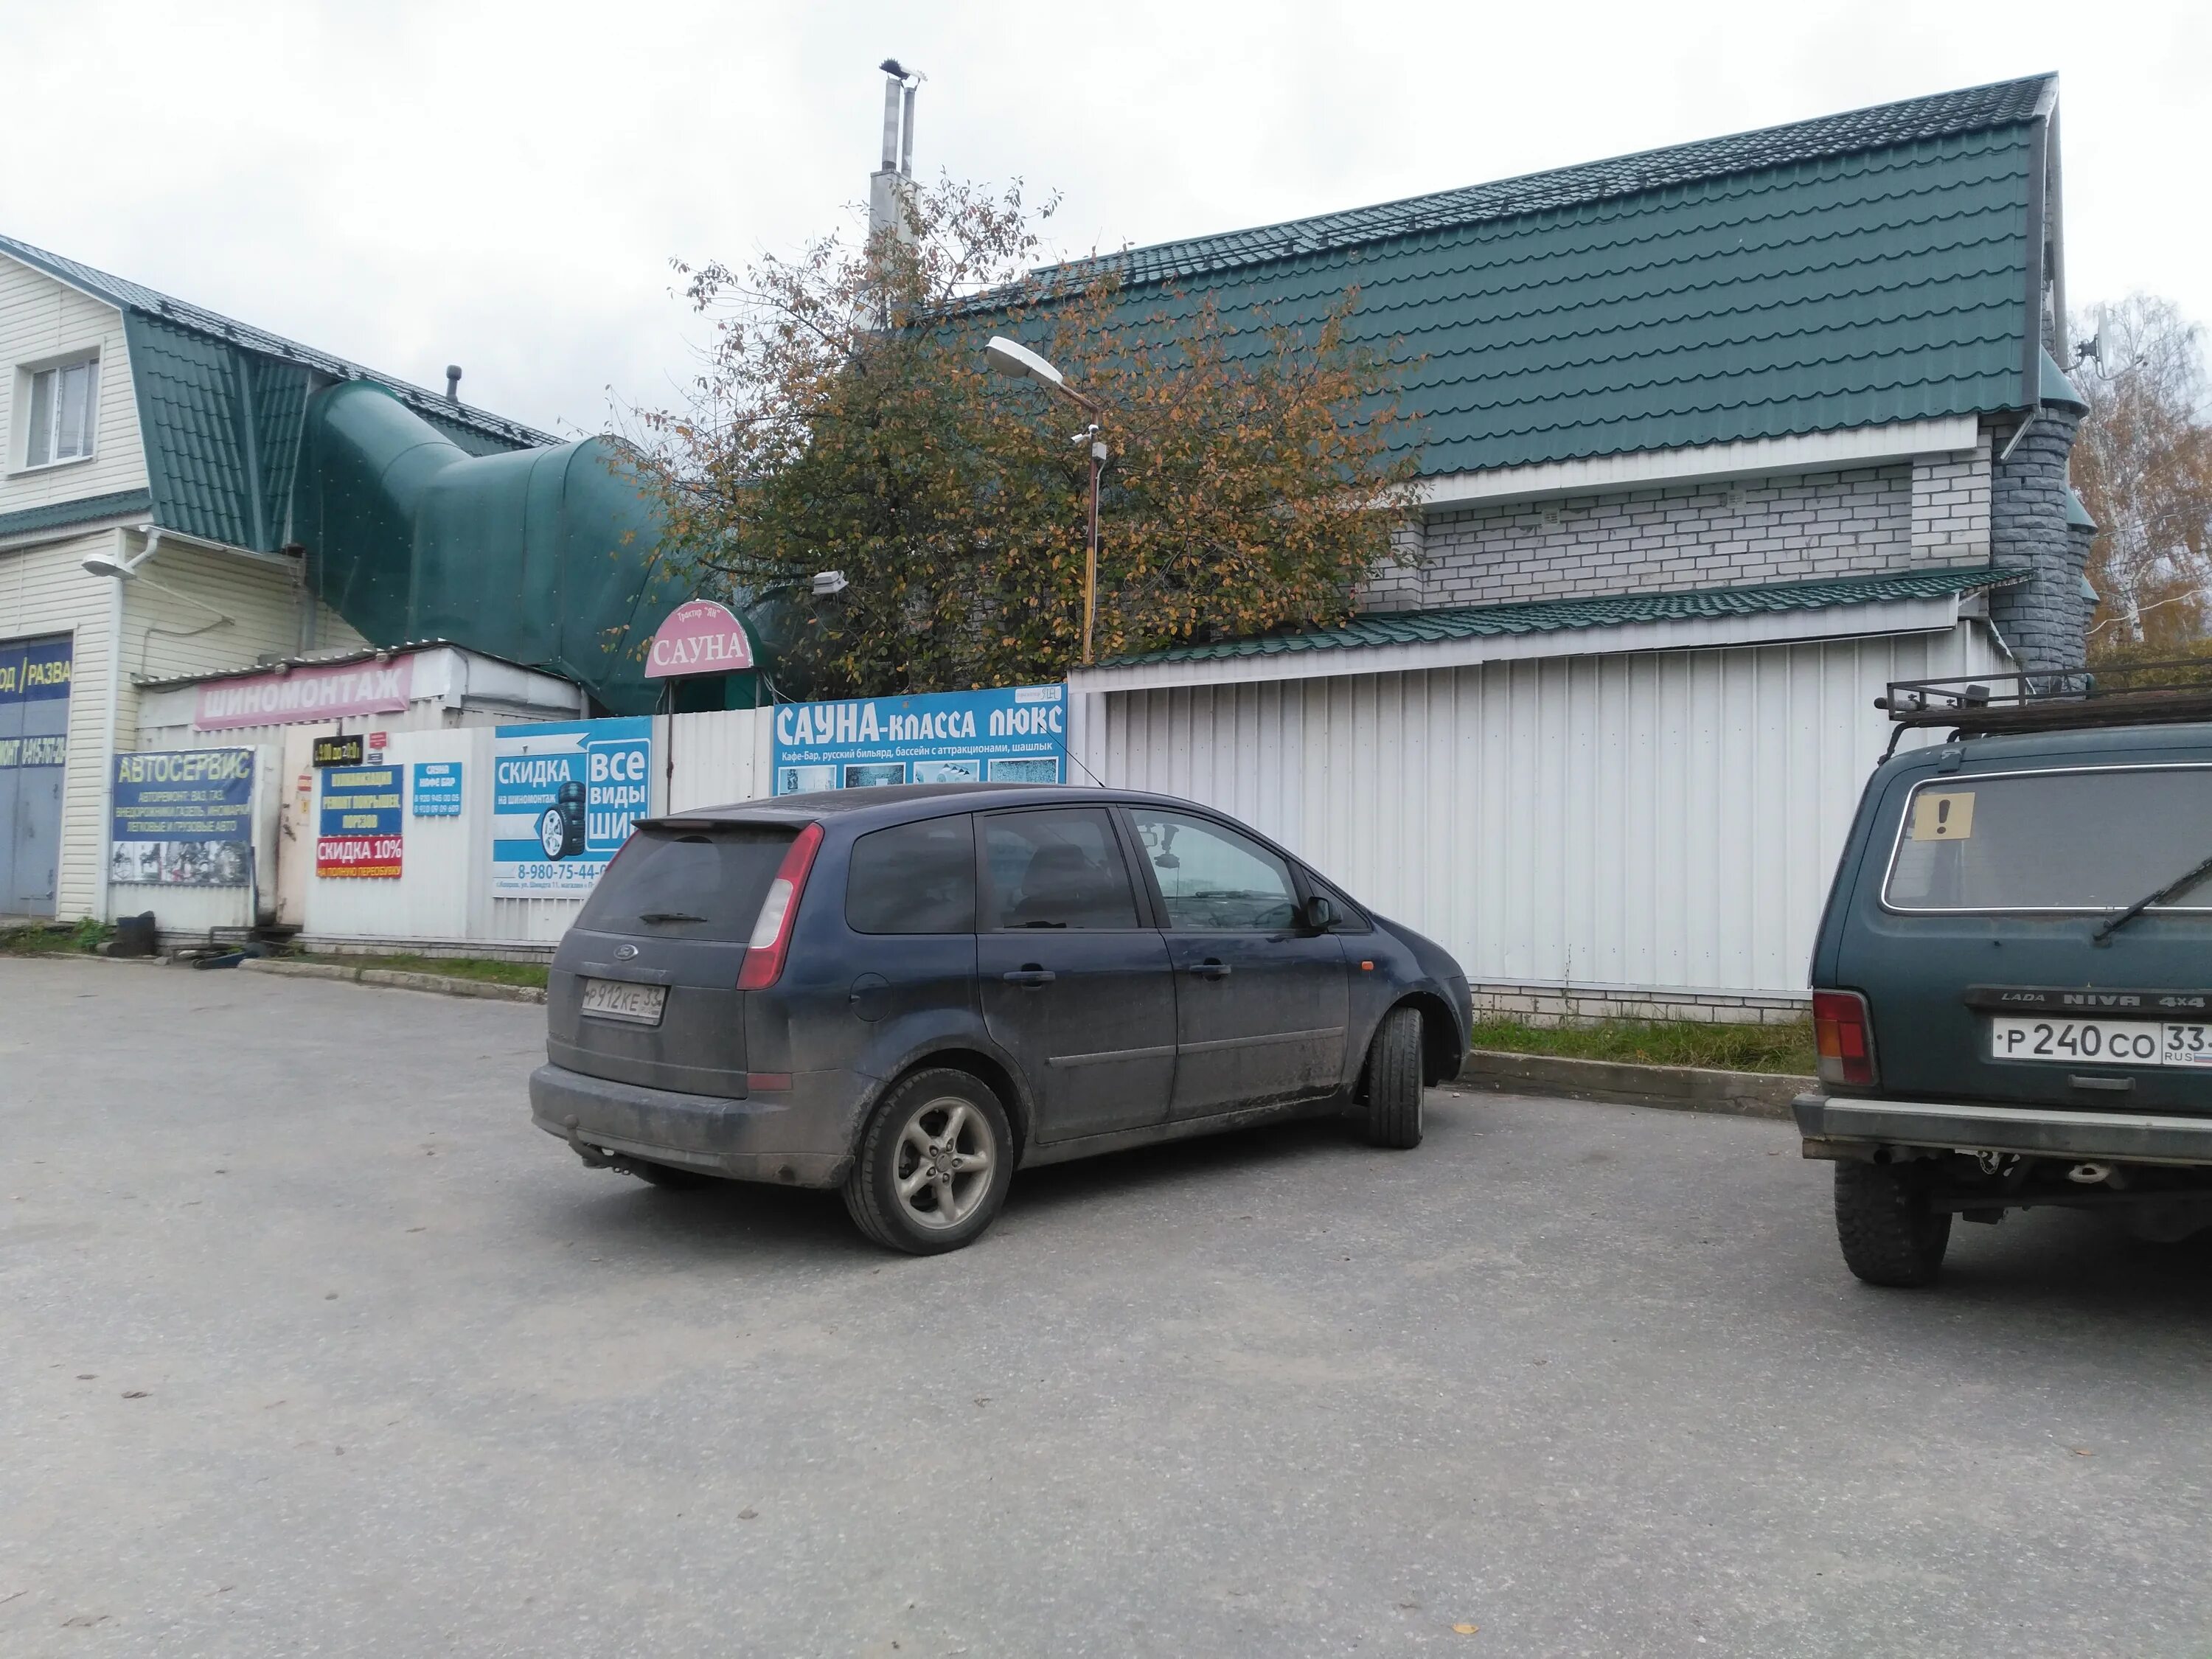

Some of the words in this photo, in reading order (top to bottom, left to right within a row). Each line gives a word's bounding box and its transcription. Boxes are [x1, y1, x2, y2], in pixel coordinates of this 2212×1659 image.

[653, 632, 744, 666] САУНА
[204, 668, 404, 718] ШИНОМОНТАЖ
[782, 751, 821, 763] Кафе-Бар,
[822, 748, 855, 762] русский
[856, 747, 894, 759] бильярд,
[895, 745, 930, 757] бассейн
[931, 747, 936, 755] с
[937, 744, 1010, 757] аттракционами,
[1012, 742, 1053, 752] шашлык
[118, 751, 250, 783] АВТОСЕРВИС
[498, 759, 571, 788] СКИДКА
[498, 796, 507, 805] на
[508, 793, 557, 805] шиномонтаж
[318, 841, 371, 864] СКИДКА
[374, 839, 402, 859] 10%
[2001, 992, 2045, 1002] LADA
[2063, 994, 2141, 1006] NIVA
[2166, 1026, 2205, 1052] 33
[2164, 1052, 2193, 1062] RUS
